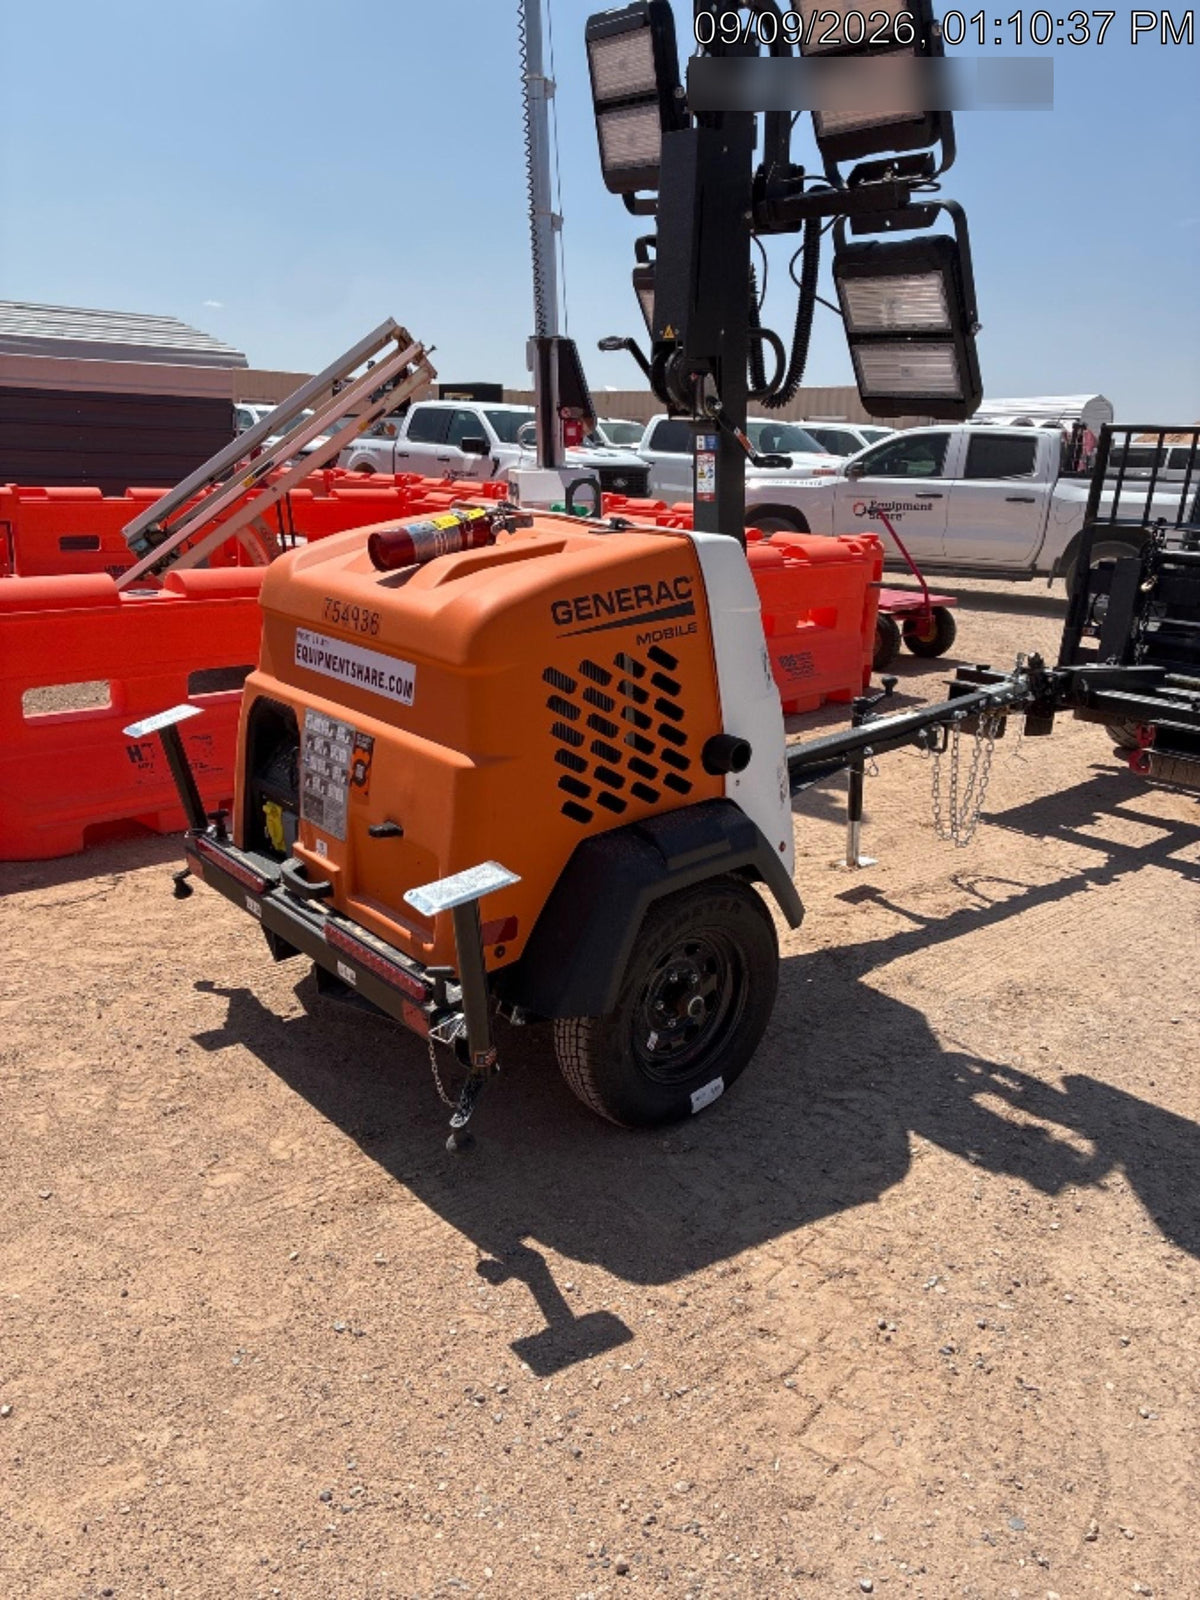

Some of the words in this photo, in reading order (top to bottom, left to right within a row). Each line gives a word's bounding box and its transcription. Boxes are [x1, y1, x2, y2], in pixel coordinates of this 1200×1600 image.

[322, 597, 381, 636] 754936
[551, 576, 694, 626] GENERAC
[636, 621, 698, 646] MOBILE
[296, 643, 413, 700] EQUIPMENTSHARE.COM
